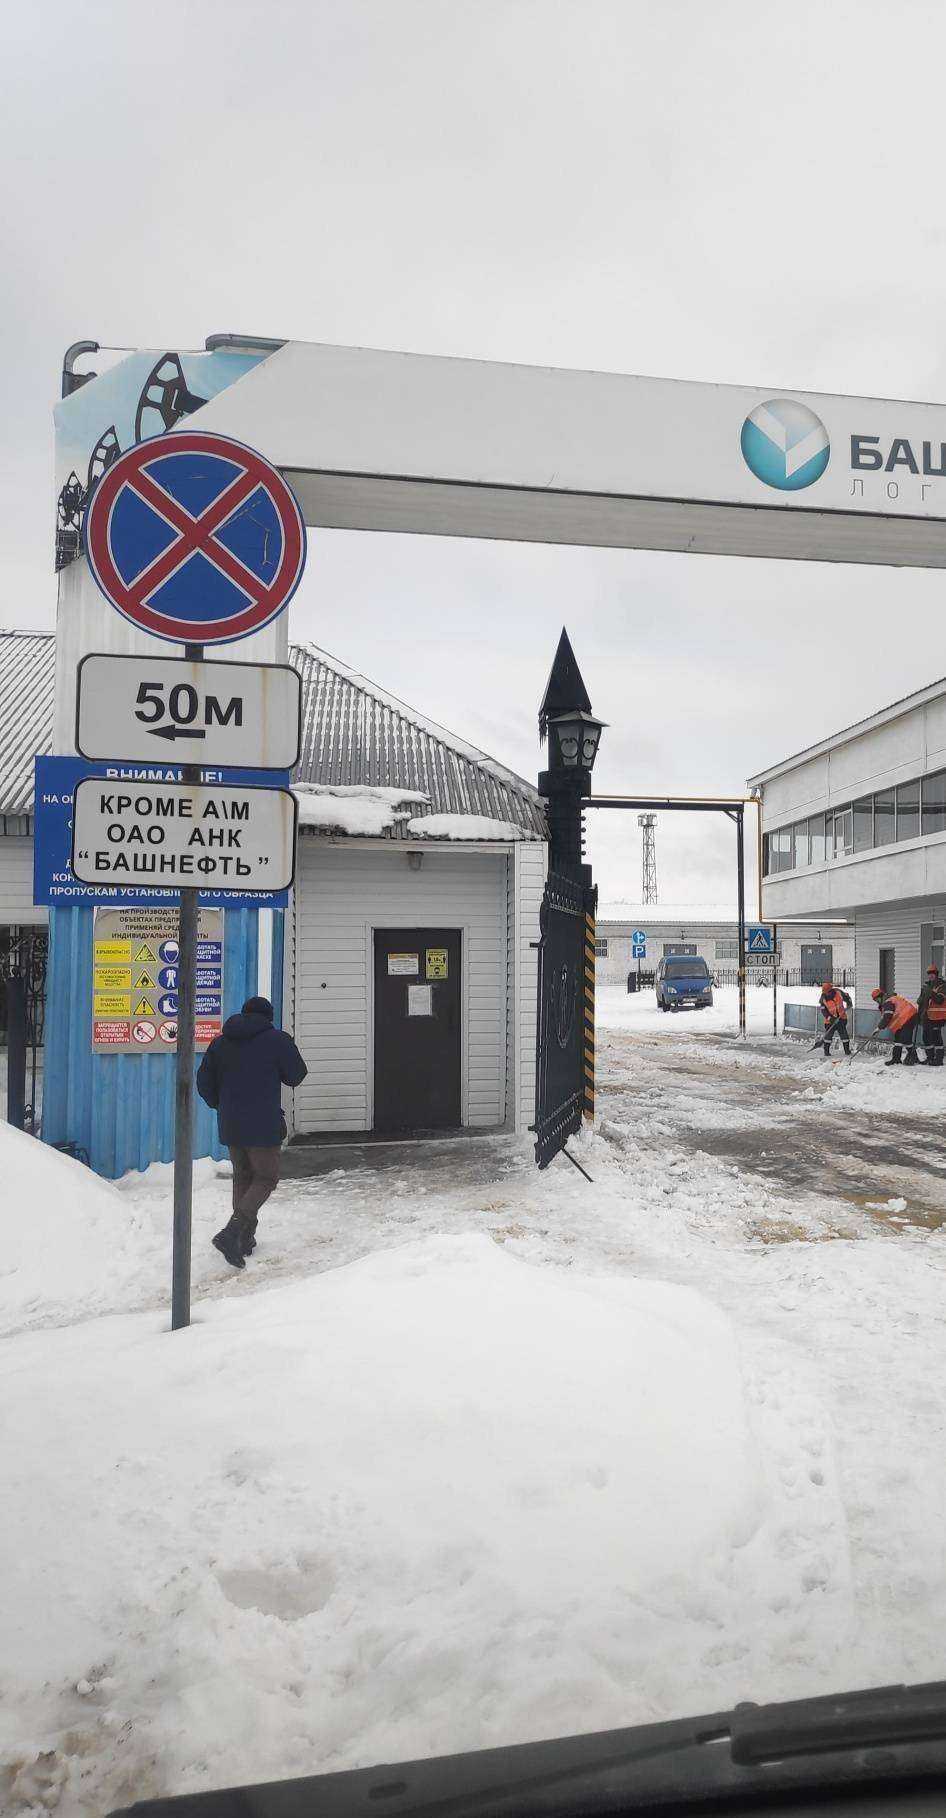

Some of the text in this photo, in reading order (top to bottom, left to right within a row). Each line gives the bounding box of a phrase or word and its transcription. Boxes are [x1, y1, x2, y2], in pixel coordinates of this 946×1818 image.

[106, 767, 223, 783] ВНИМАЕ!
[43, 794, 59, 804] НА
[100, 794, 193, 818] КРОМЕ
[106, 823, 242, 848] ОАО АНК
[49, 886, 117, 896] ПРОПУСКАМ
[111, 932, 178, 940] ИНДИВИДУАЛЬНОЙ
[746, 955, 776, 964] СТОП
